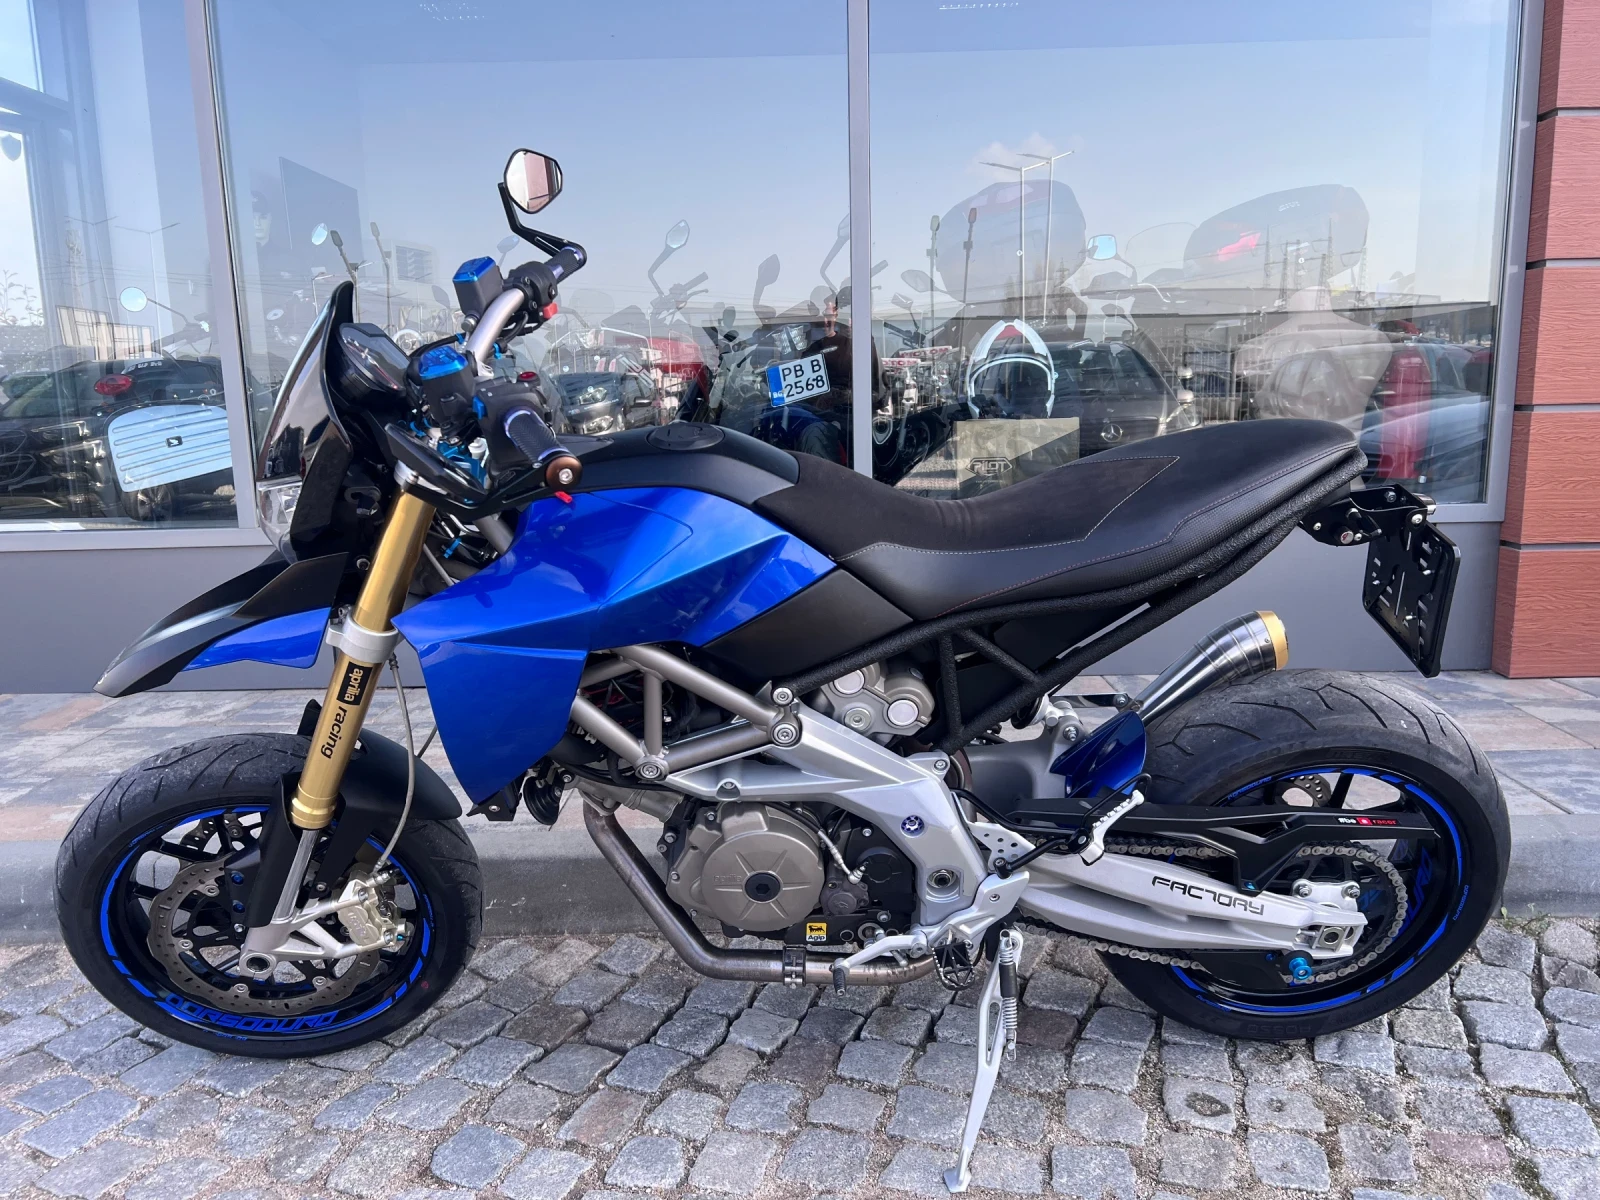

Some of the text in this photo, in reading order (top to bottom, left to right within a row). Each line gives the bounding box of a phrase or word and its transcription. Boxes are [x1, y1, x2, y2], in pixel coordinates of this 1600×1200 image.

[782, 359, 821, 381] PB B
[784, 375, 825, 398] 2568
[321, 668, 364, 759] aprilia racing
[1151, 876, 1265, 915] FACTORY
